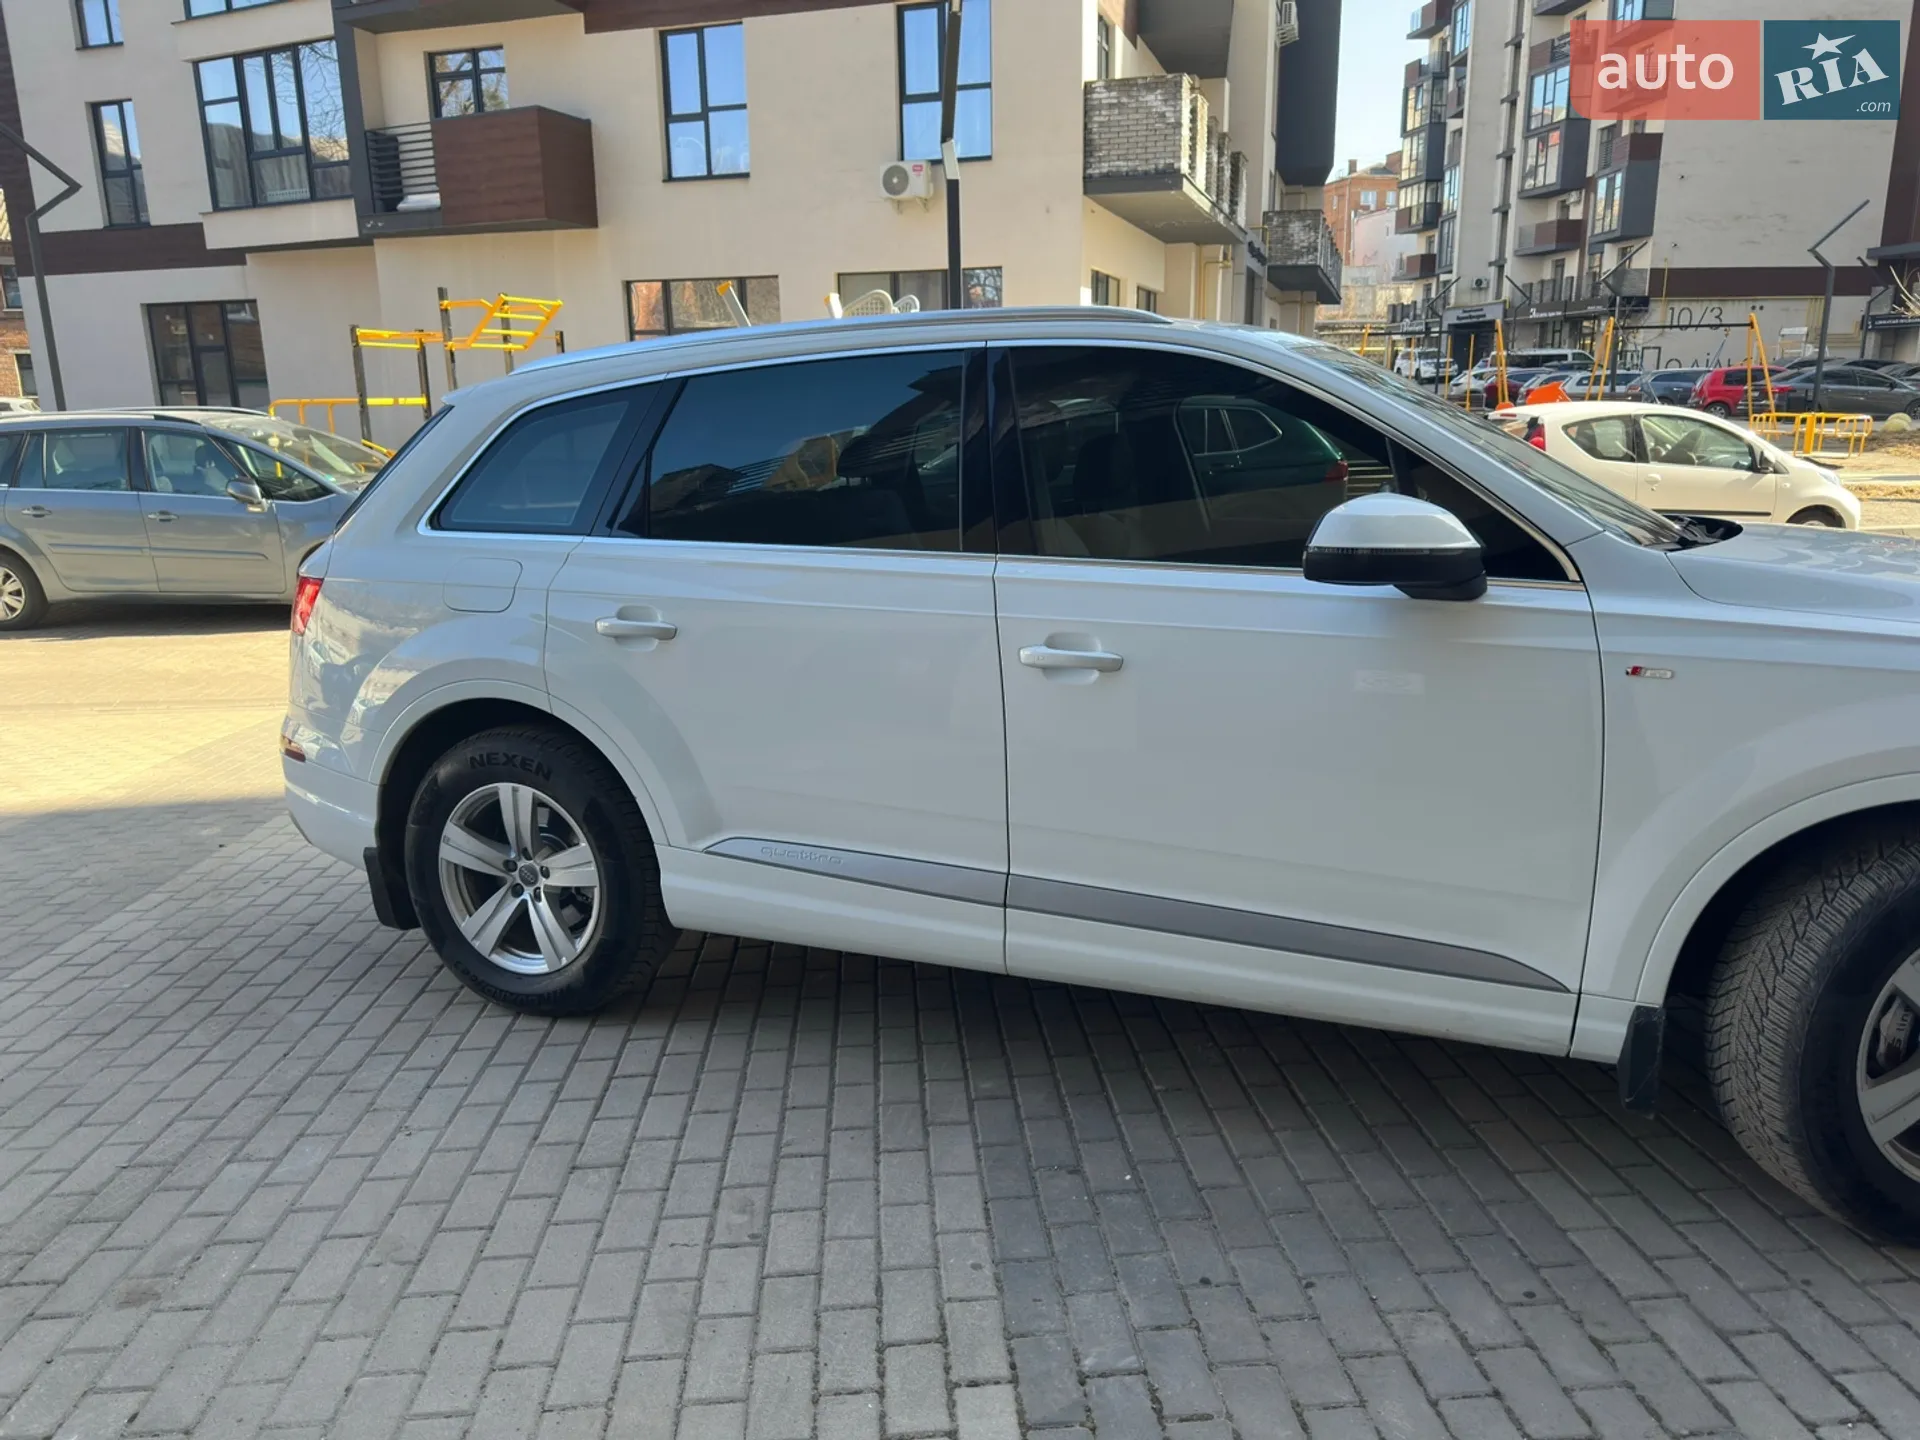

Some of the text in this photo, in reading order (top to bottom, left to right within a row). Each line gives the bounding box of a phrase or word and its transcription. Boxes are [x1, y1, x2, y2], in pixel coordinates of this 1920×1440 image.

[1669, 306, 1723, 331] 10/3
[470, 752, 553, 780] NEXEN
[761, 846, 843, 865] quattro
